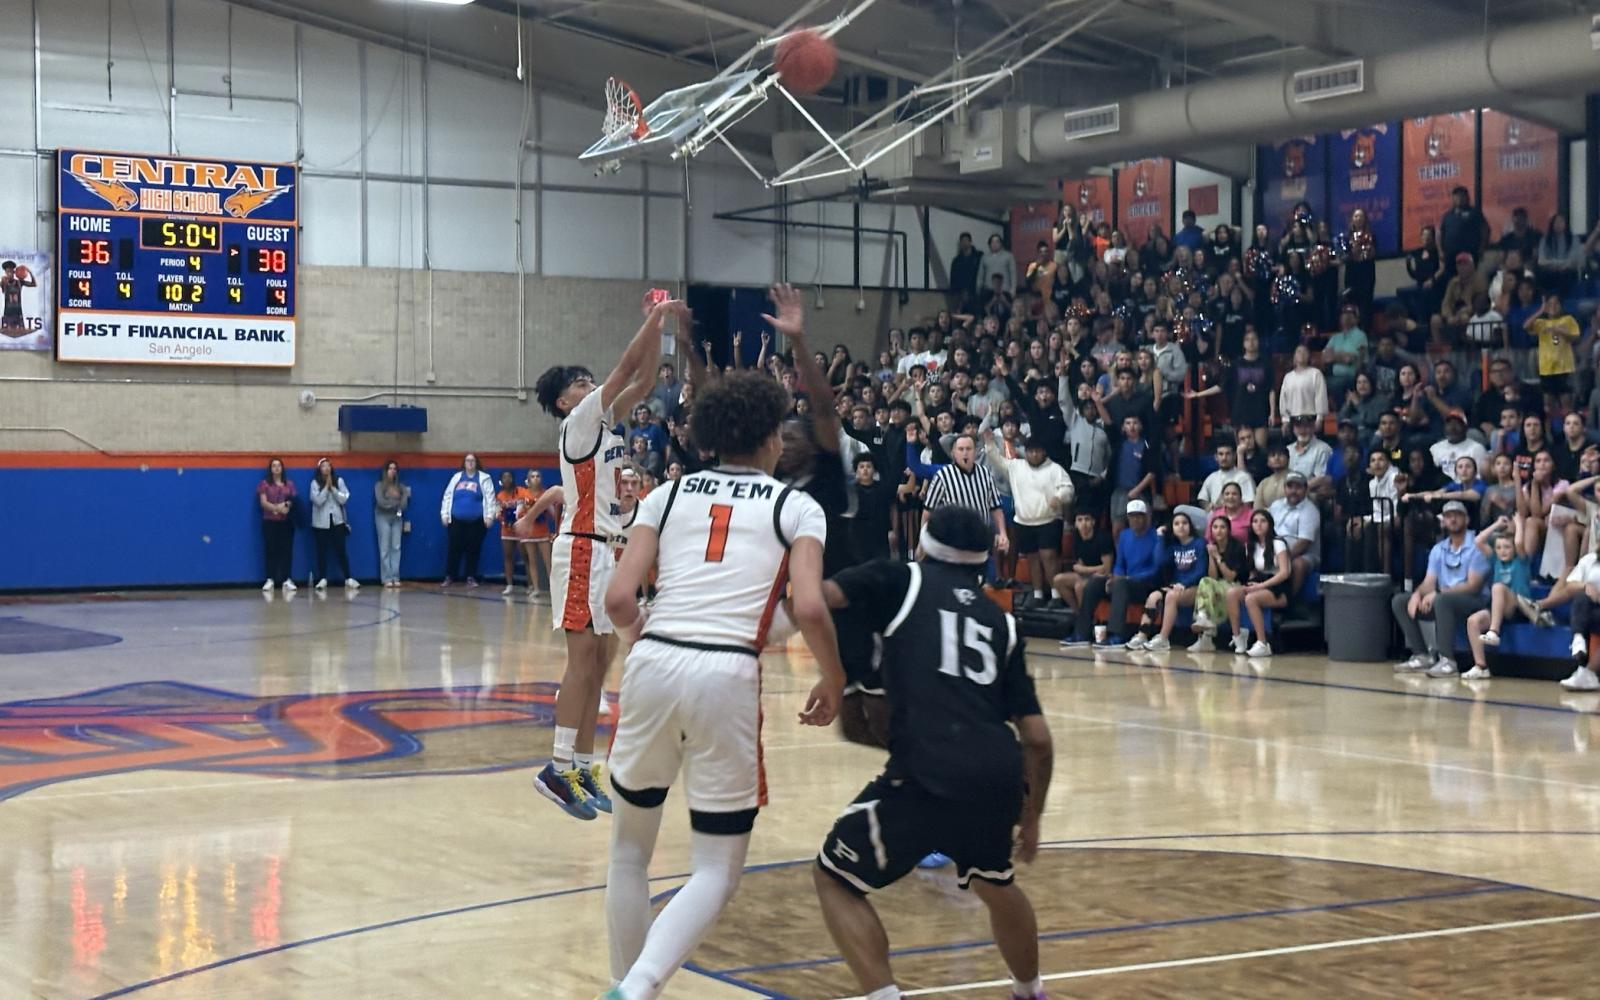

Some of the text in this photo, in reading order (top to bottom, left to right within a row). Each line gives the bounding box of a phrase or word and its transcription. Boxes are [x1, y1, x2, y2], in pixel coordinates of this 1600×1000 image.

[71, 154, 290, 193] CENTRAL
[140, 188, 223, 214] HIGH SCHOOL
[70, 216, 111, 232] HOME
[162, 222, 216, 247] 5:04
[247, 226, 289, 242] GUEST
[80, 239, 110, 264] 36
[160, 256, 201, 271] PERIOD 4
[259, 249, 286, 273] 38
[68, 270, 91, 278] FOULS
[115, 272, 135, 281] T.O.L.
[158, 274, 206, 285] PLAYER FOUL
[227, 277, 245, 286] T.O.L.
[78, 281, 90, 296] 4
[119, 282, 131, 298] 4
[266, 279, 288, 288] FOULS
[165, 284, 203, 302] 10 2
[230, 287, 241, 303] 4
[275, 290, 286, 305] 4
[68, 299, 92, 308] SCORE
[168, 303, 193, 312] MATCH
[266, 307, 288, 316] SCORE
[64, 321, 286, 343] FIRST FINANCIAL BANK
[149, 342, 212, 357] San Angelo
[683, 477, 774, 499] SIC 'EM
[704, 503, 734, 562] 1
[937, 608, 997, 685] 15
[832, 837, 860, 863] P
